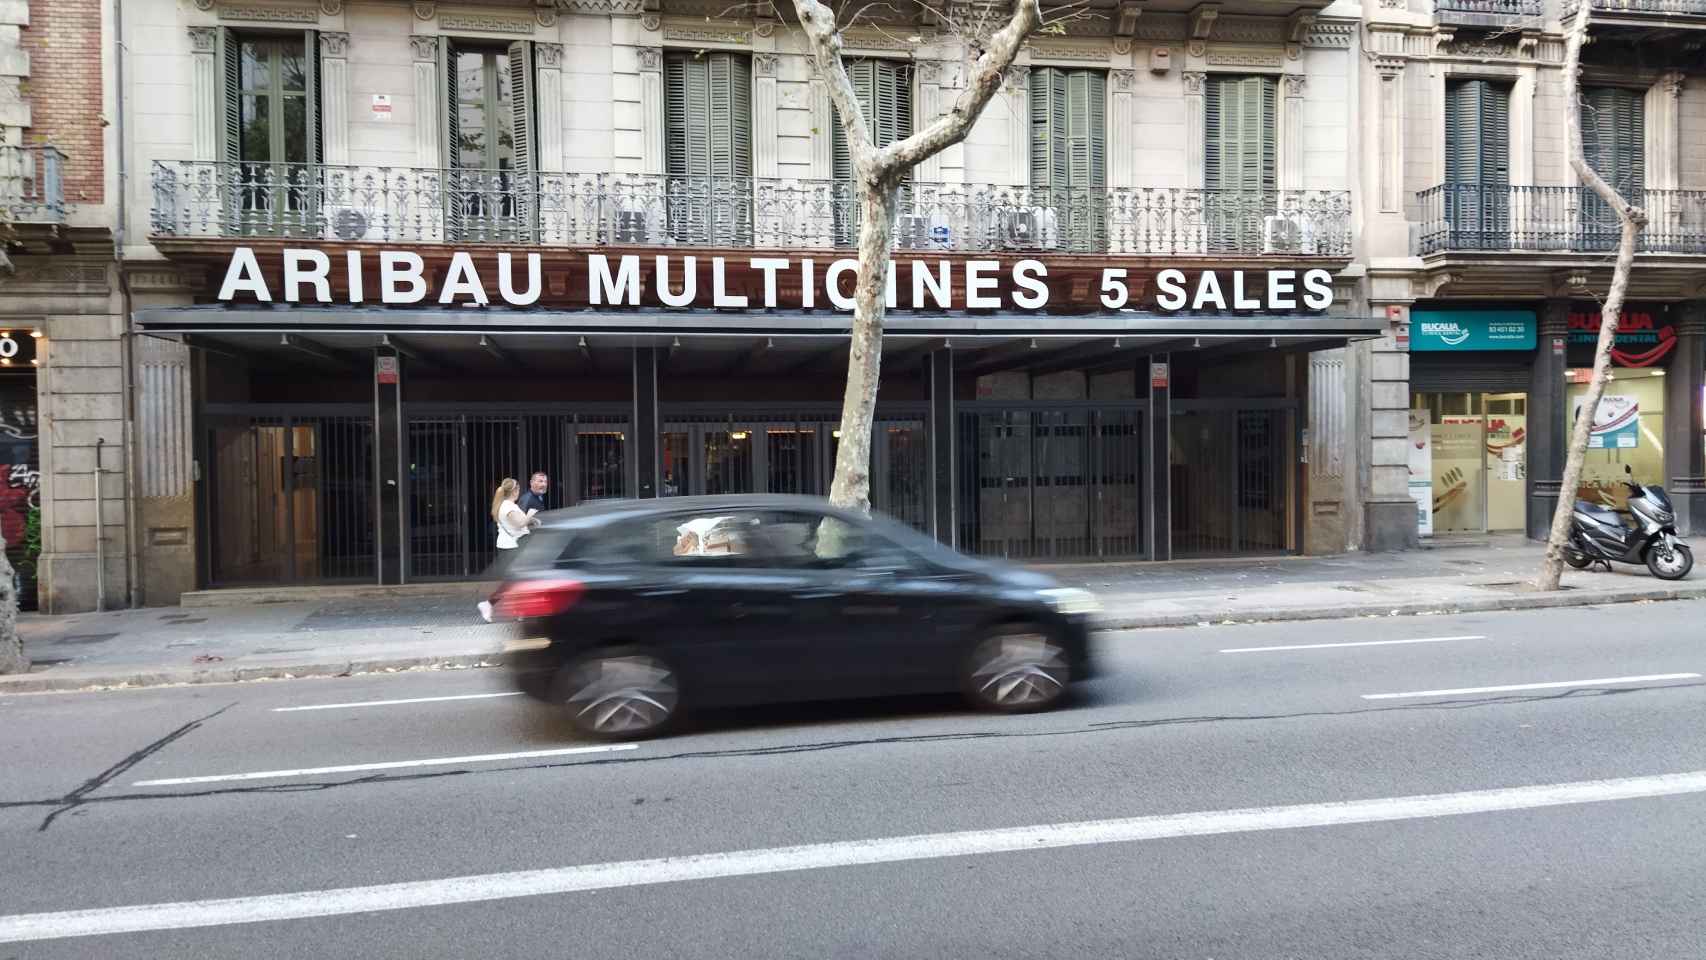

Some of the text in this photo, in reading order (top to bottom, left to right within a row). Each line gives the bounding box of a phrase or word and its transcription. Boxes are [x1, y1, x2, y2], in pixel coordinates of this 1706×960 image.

[218, 247, 1334, 311] ARIBAU MULTICINES 5 SALES
